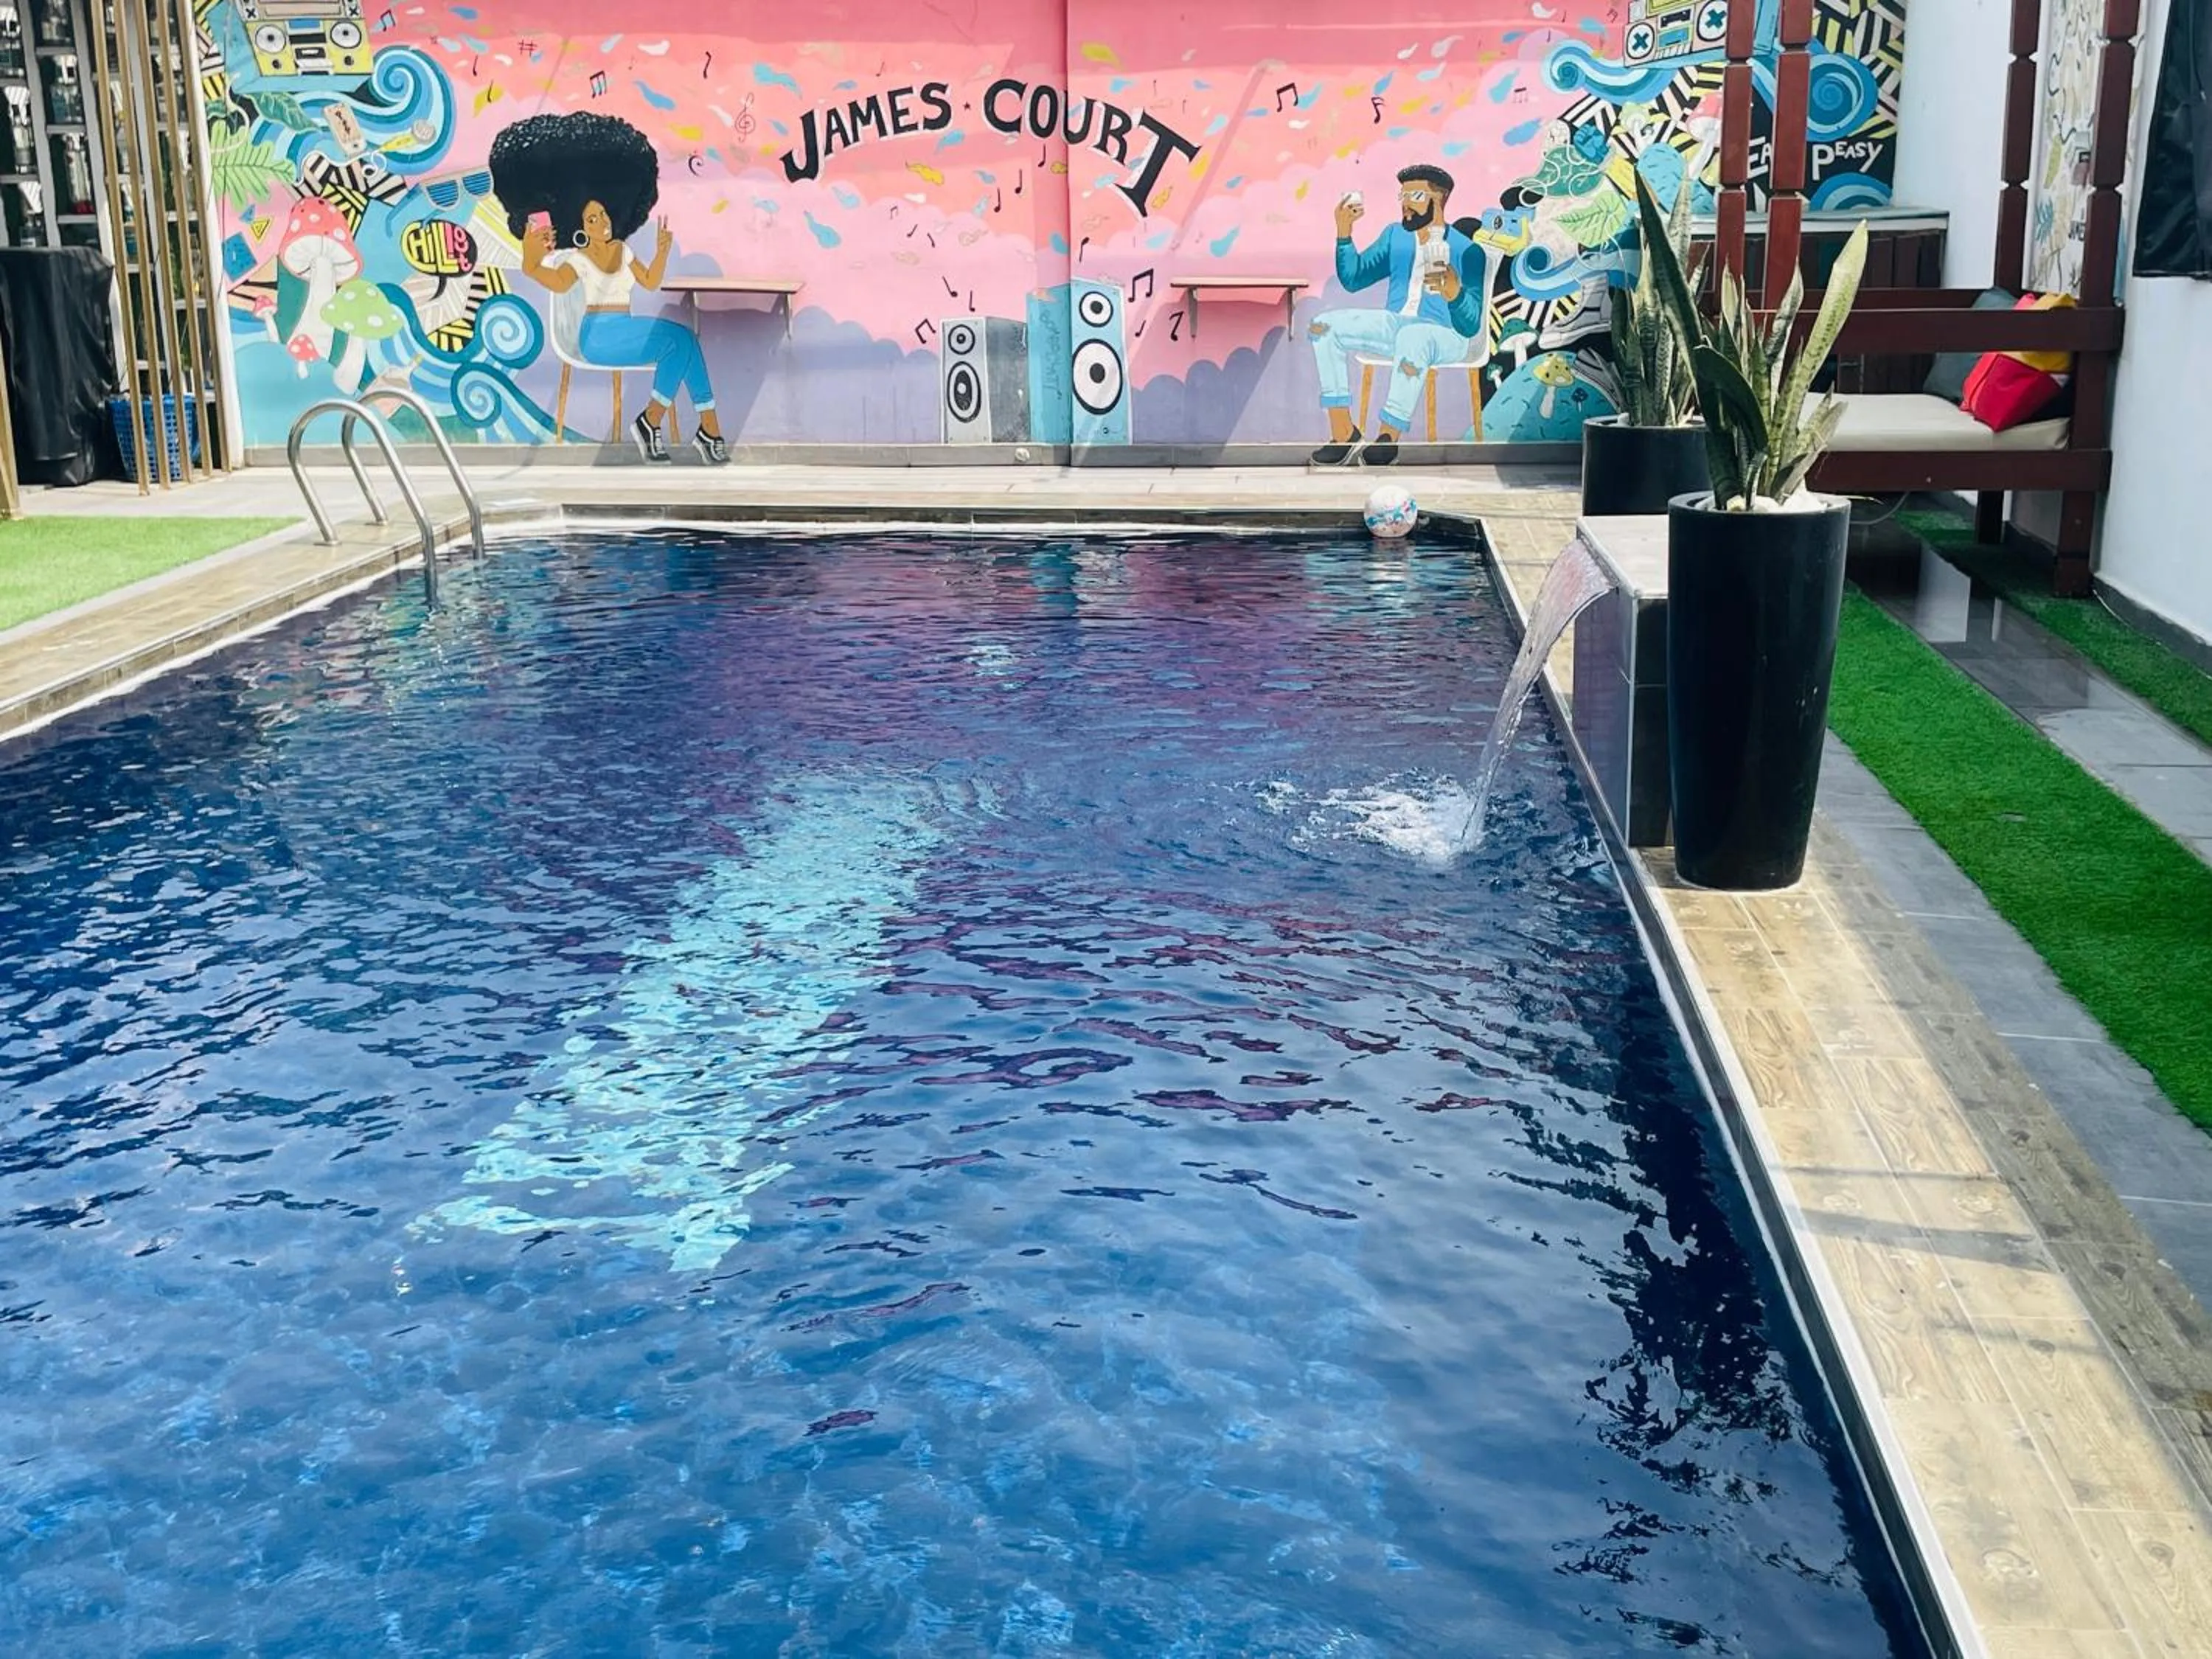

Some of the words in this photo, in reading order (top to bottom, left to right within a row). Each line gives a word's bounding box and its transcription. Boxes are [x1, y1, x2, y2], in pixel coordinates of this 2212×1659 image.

[780, 83, 953, 183] JAMES
[984, 79, 1200, 217] COURT
[1747, 136, 1773, 178] EA
[1812, 141, 1883, 181] PEASY
